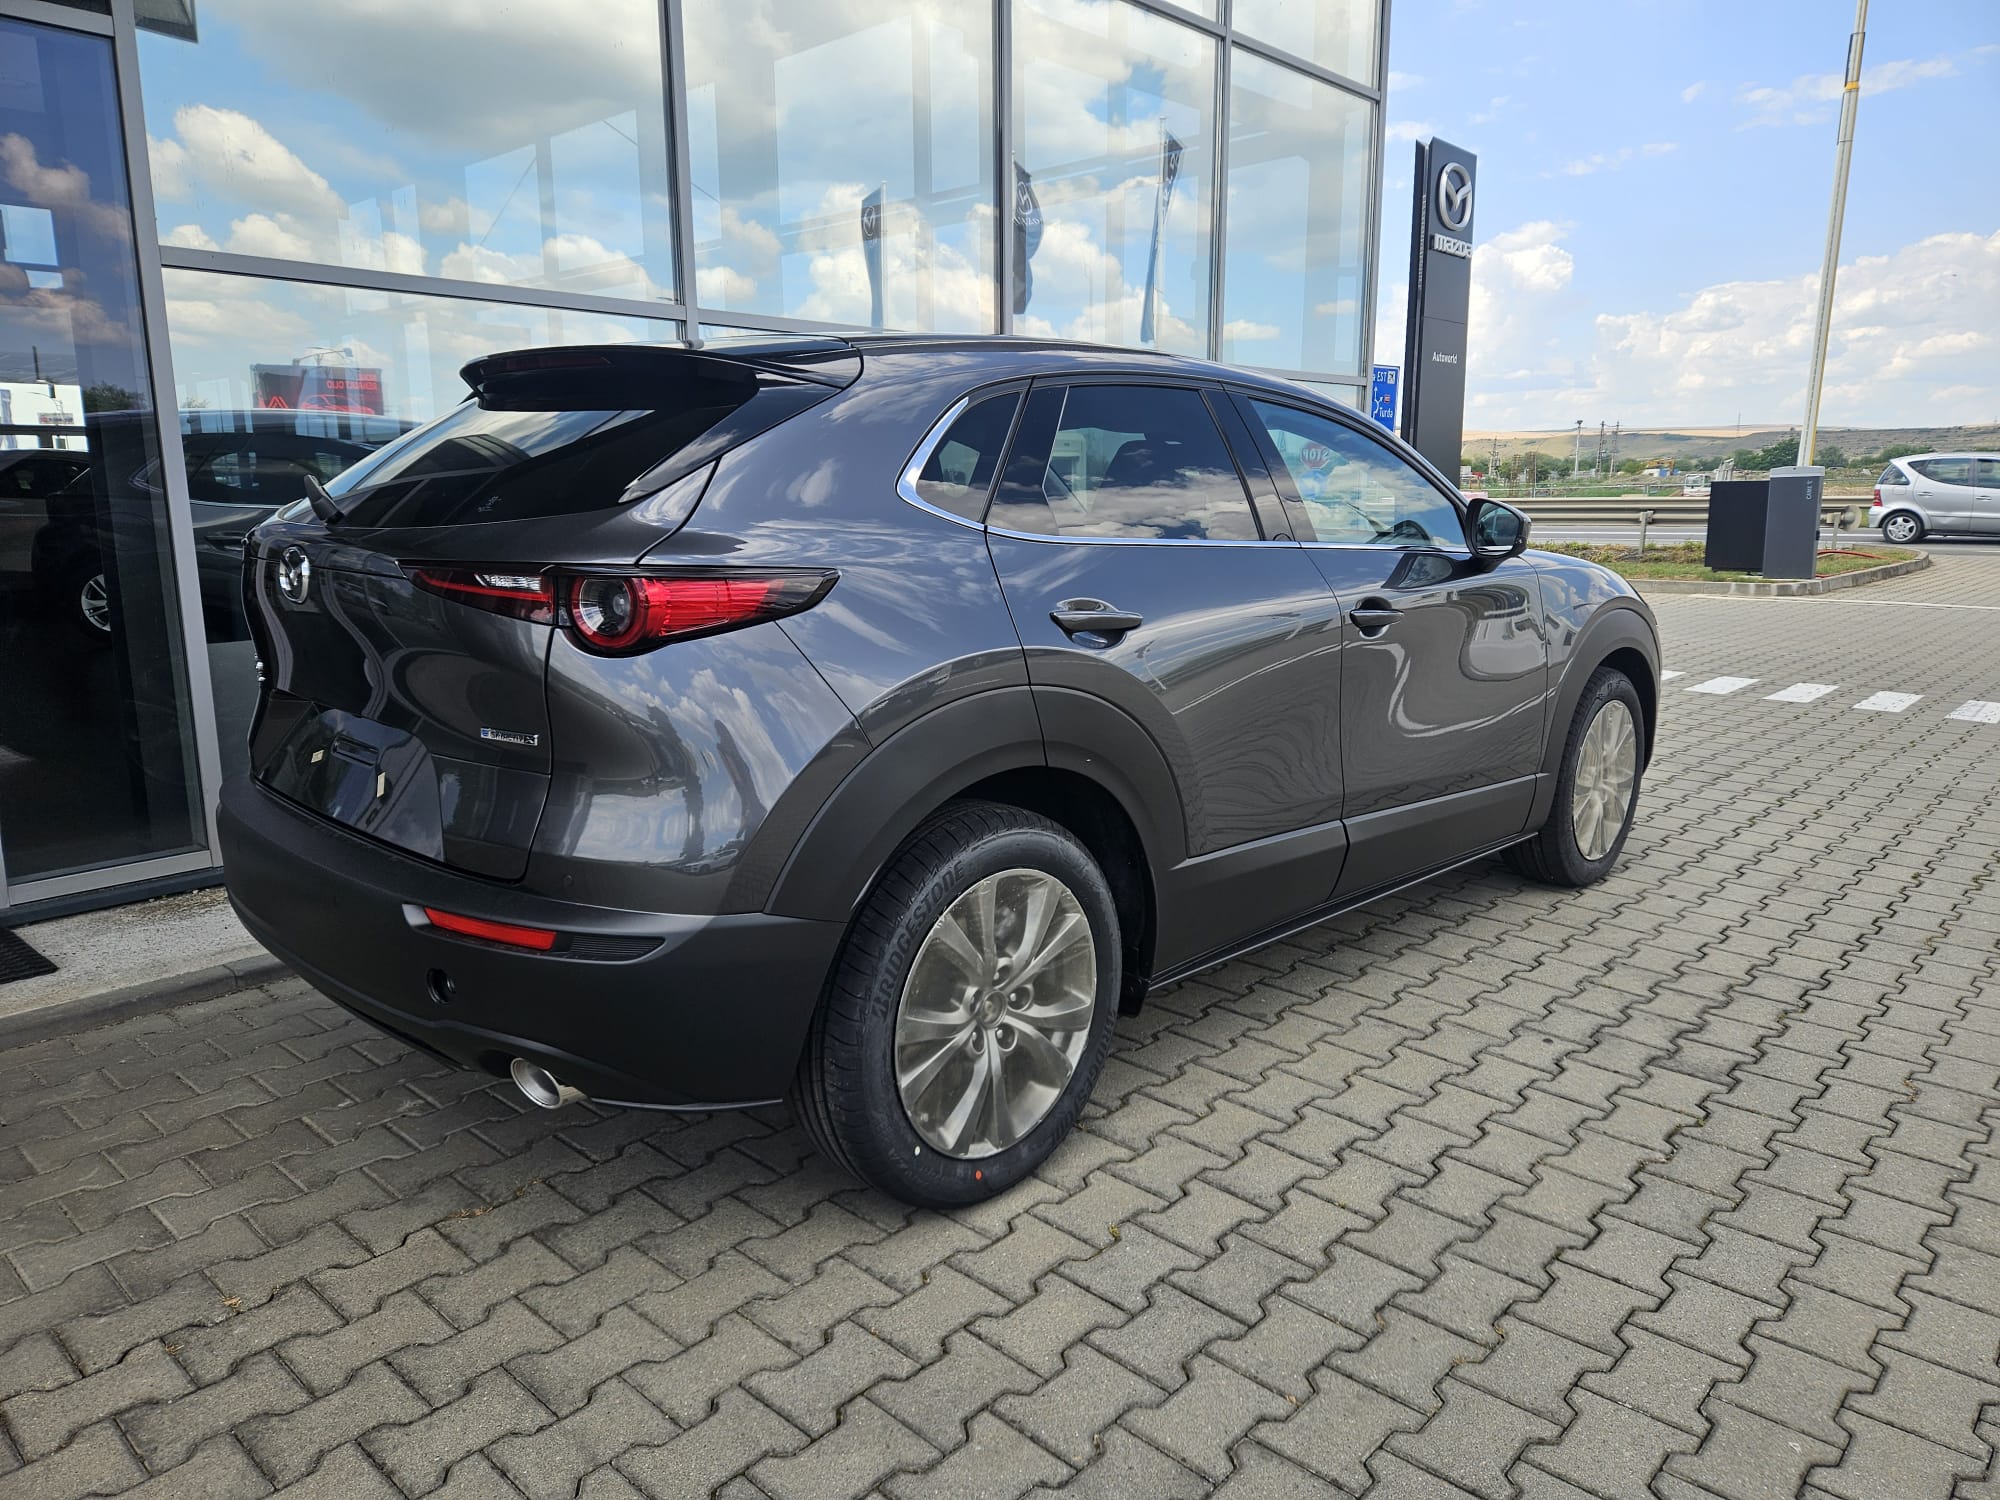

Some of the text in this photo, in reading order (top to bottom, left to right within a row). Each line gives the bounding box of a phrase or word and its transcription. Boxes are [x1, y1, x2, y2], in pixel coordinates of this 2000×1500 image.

[1432, 351, 1458, 364] Autoworld
[1377, 371, 1387, 382] EST
[1379, 407, 1394, 418] Turda
[871, 859, 964, 1023] BRIDGESTONE
